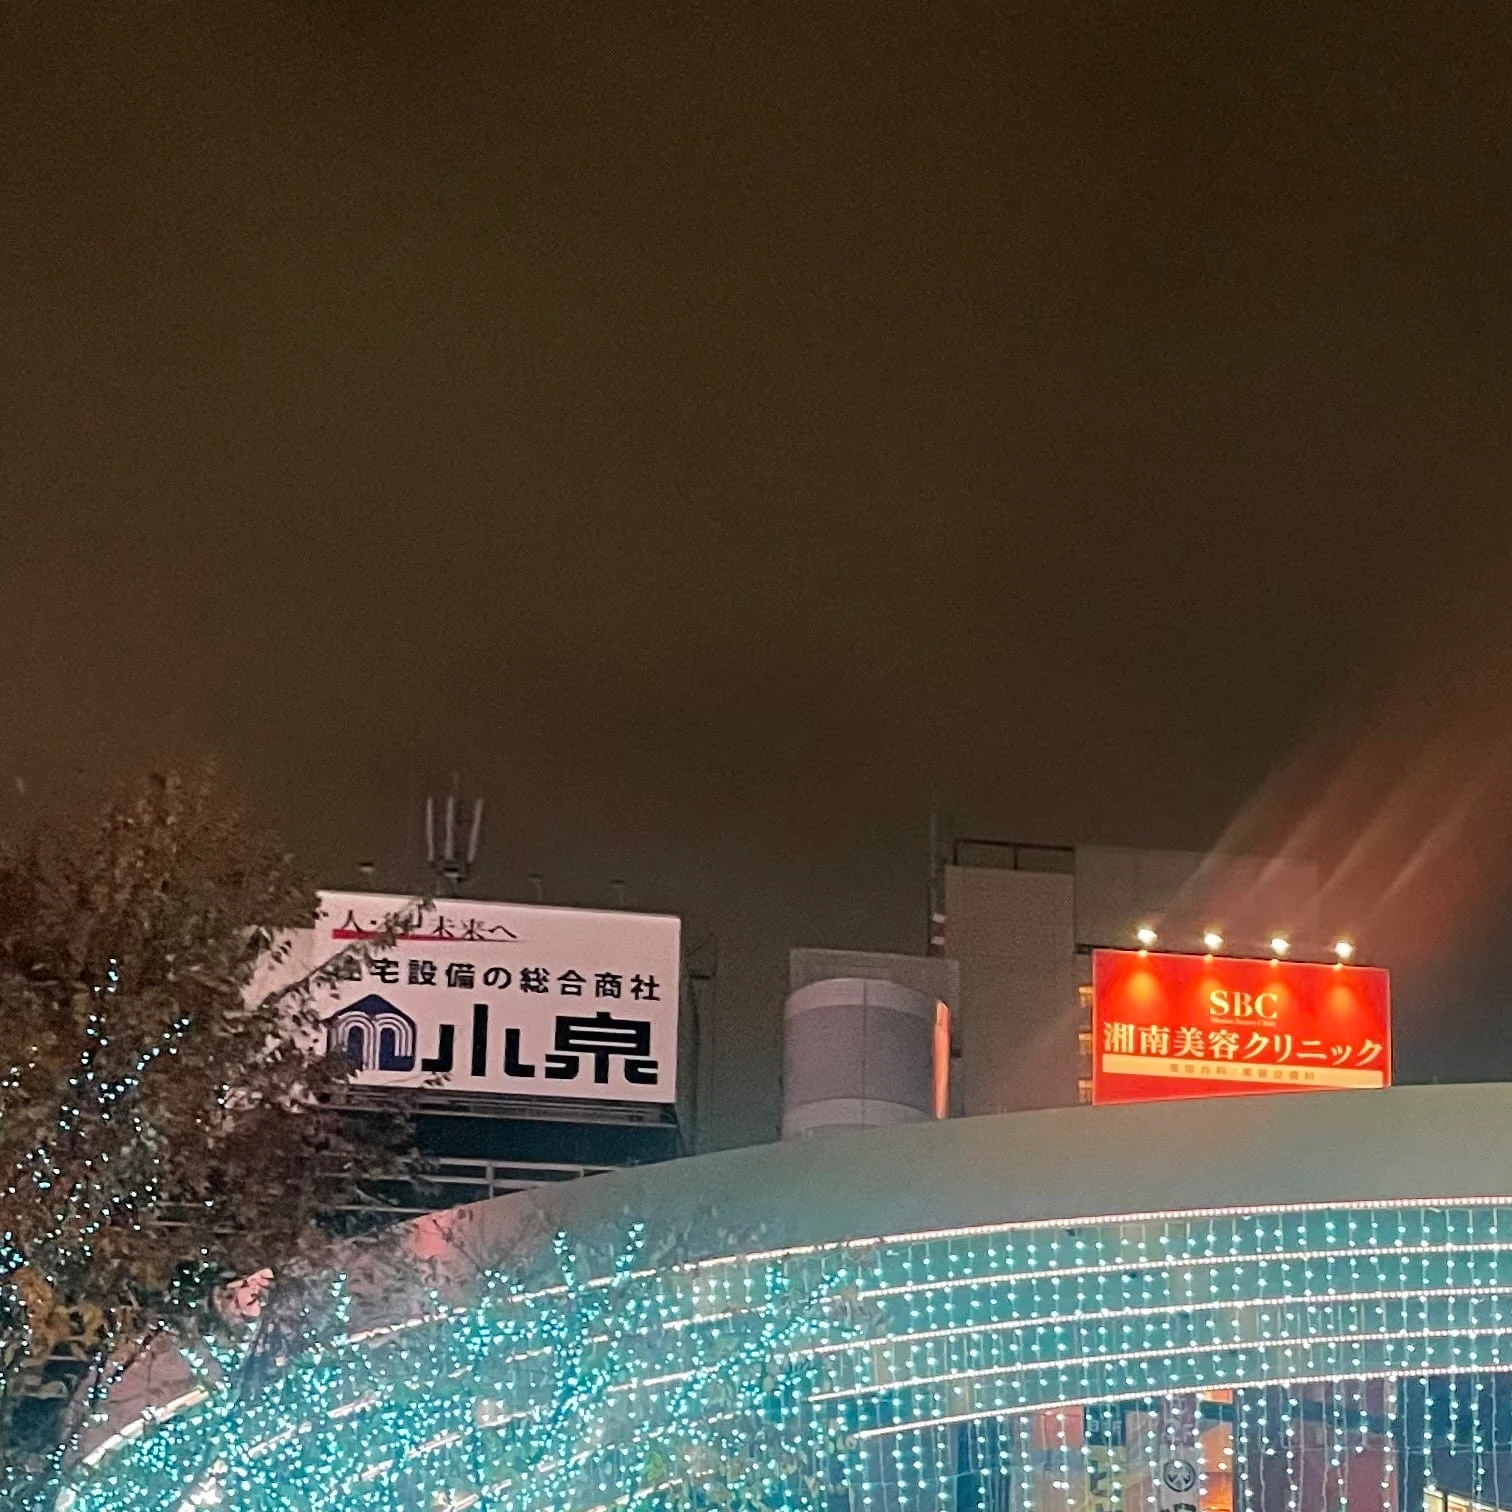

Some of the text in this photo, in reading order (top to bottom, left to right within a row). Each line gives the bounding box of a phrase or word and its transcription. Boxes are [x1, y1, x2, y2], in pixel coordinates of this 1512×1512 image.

[1209, 989, 1278, 1019] SBC
[421, 1003, 659, 1085] 小泉
[1104, 1020, 1384, 1067] 湘南美容クリニック
